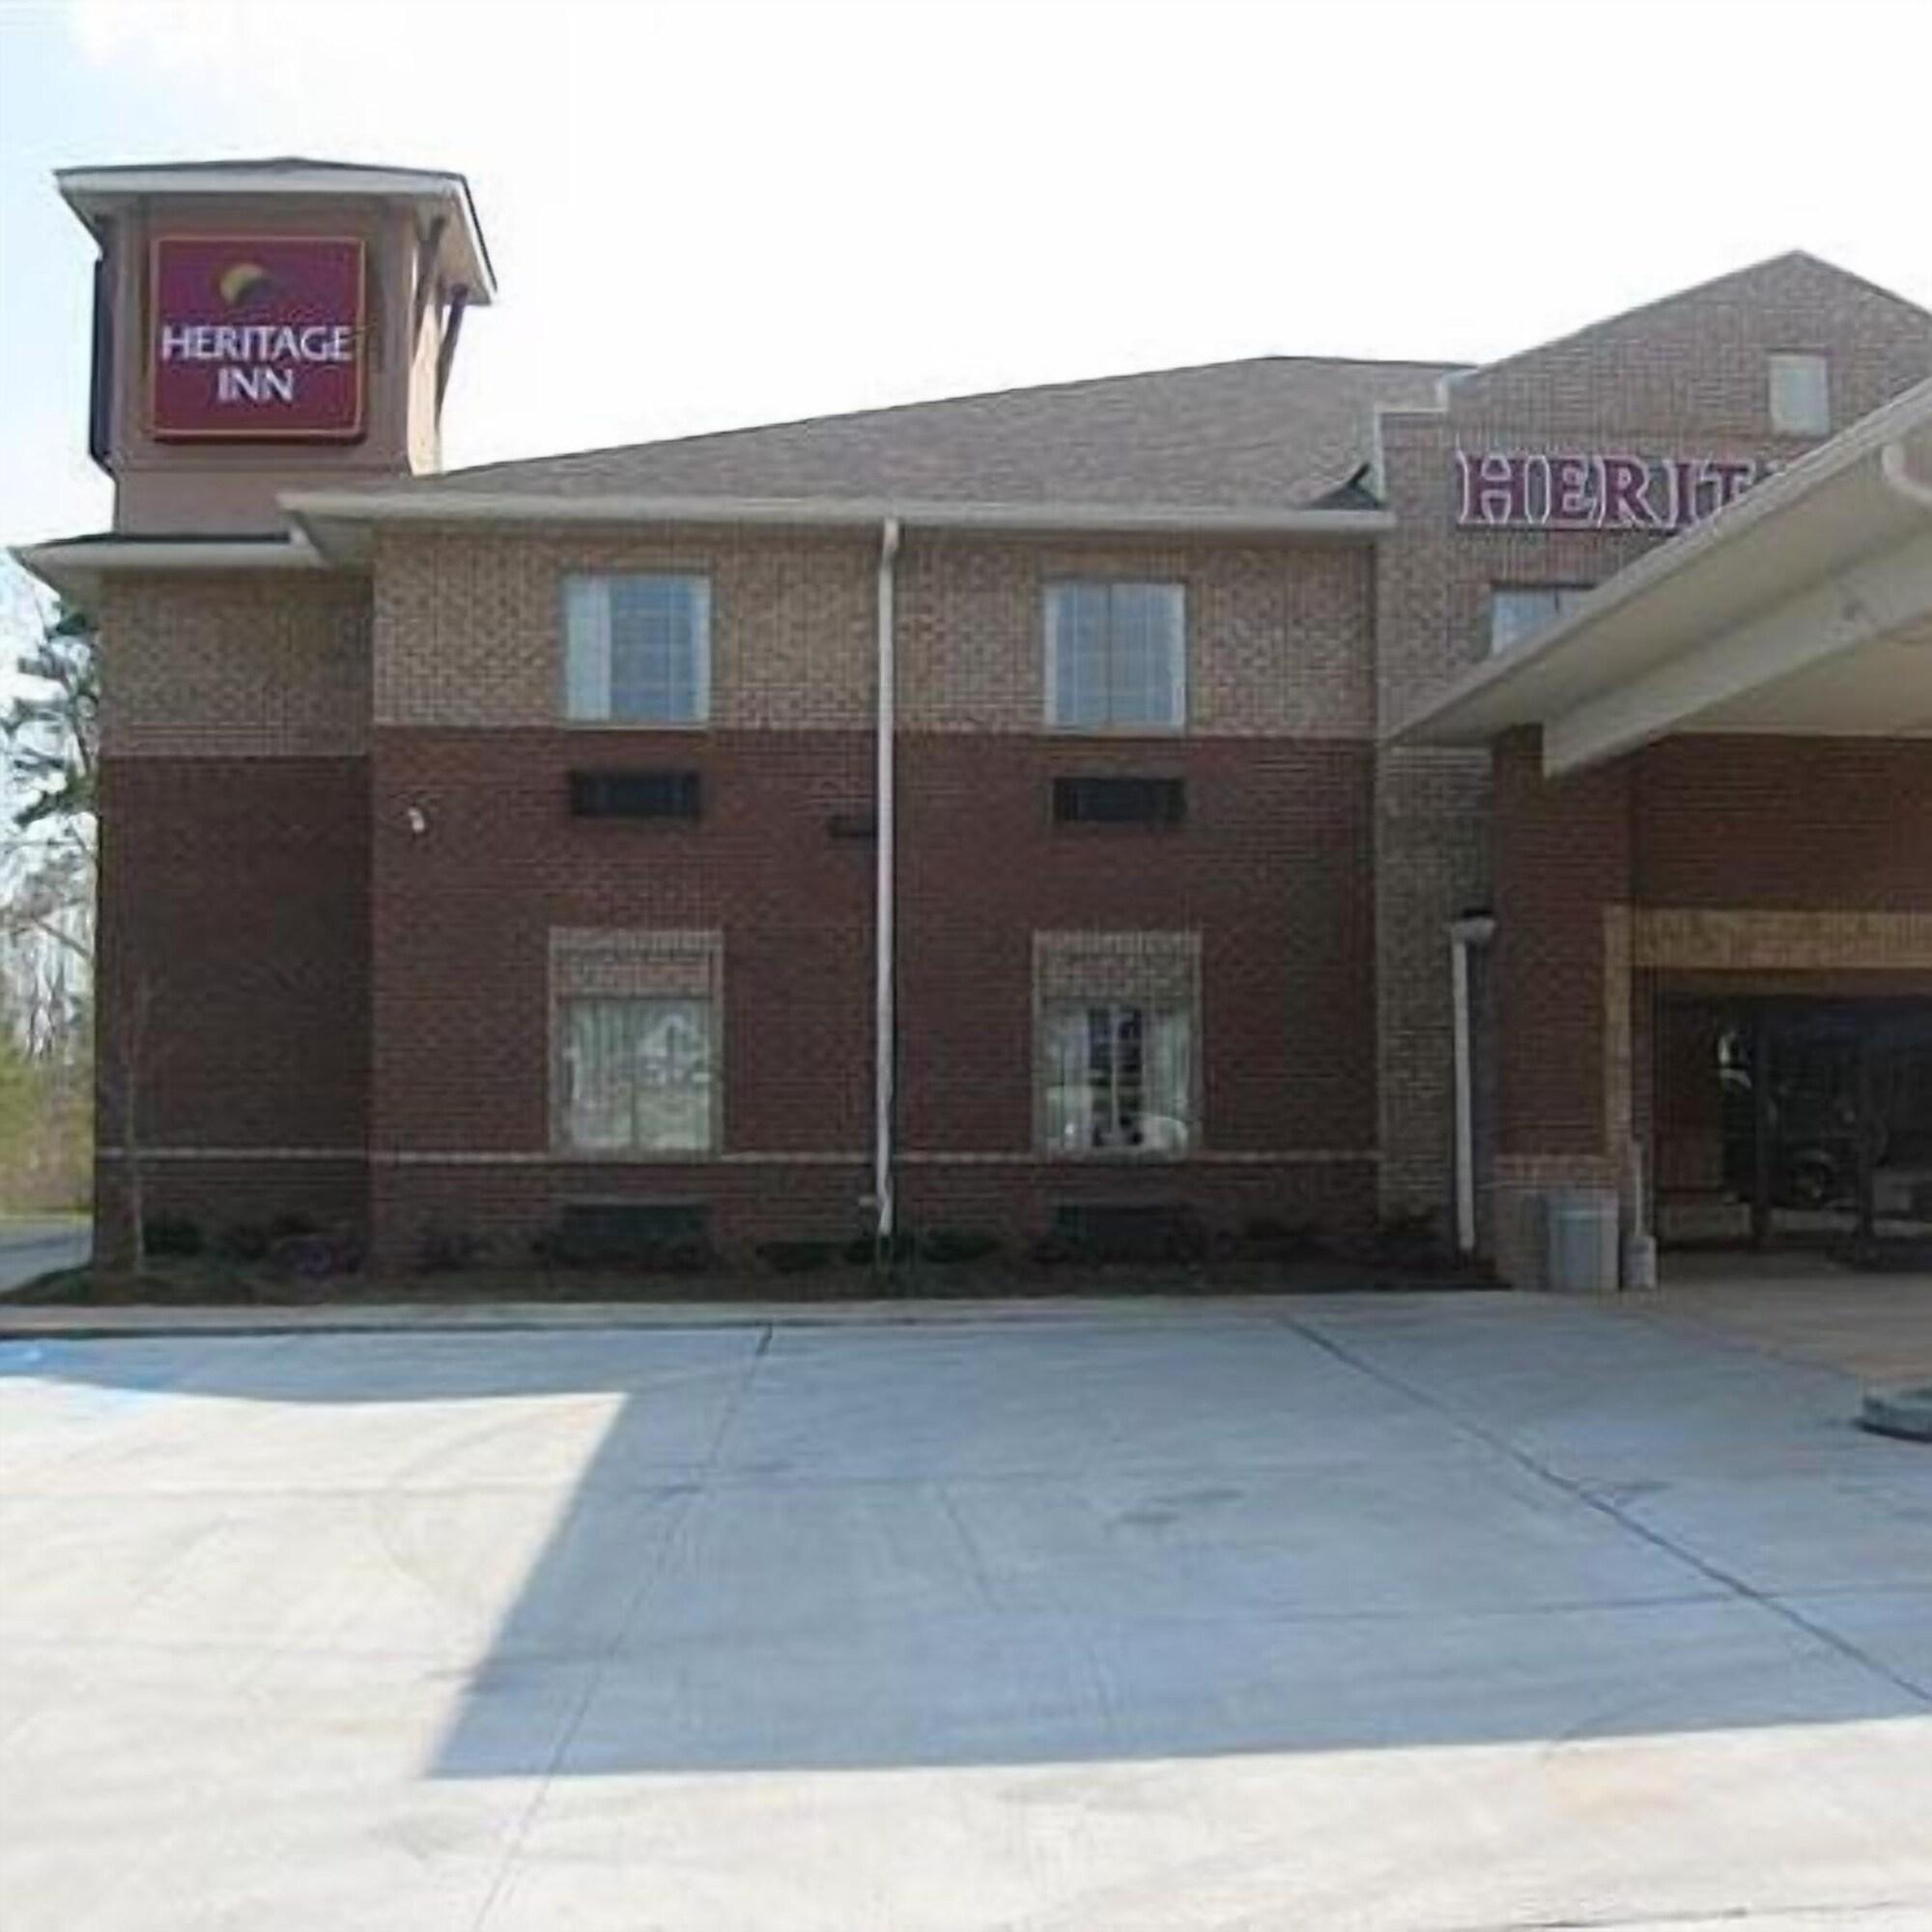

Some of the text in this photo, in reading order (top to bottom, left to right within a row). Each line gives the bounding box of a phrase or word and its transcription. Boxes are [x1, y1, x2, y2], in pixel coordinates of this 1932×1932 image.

[161, 326, 353, 361] HERITAGE
[217, 368, 295, 401] INN
[1457, 451, 1777, 529] HERIT
